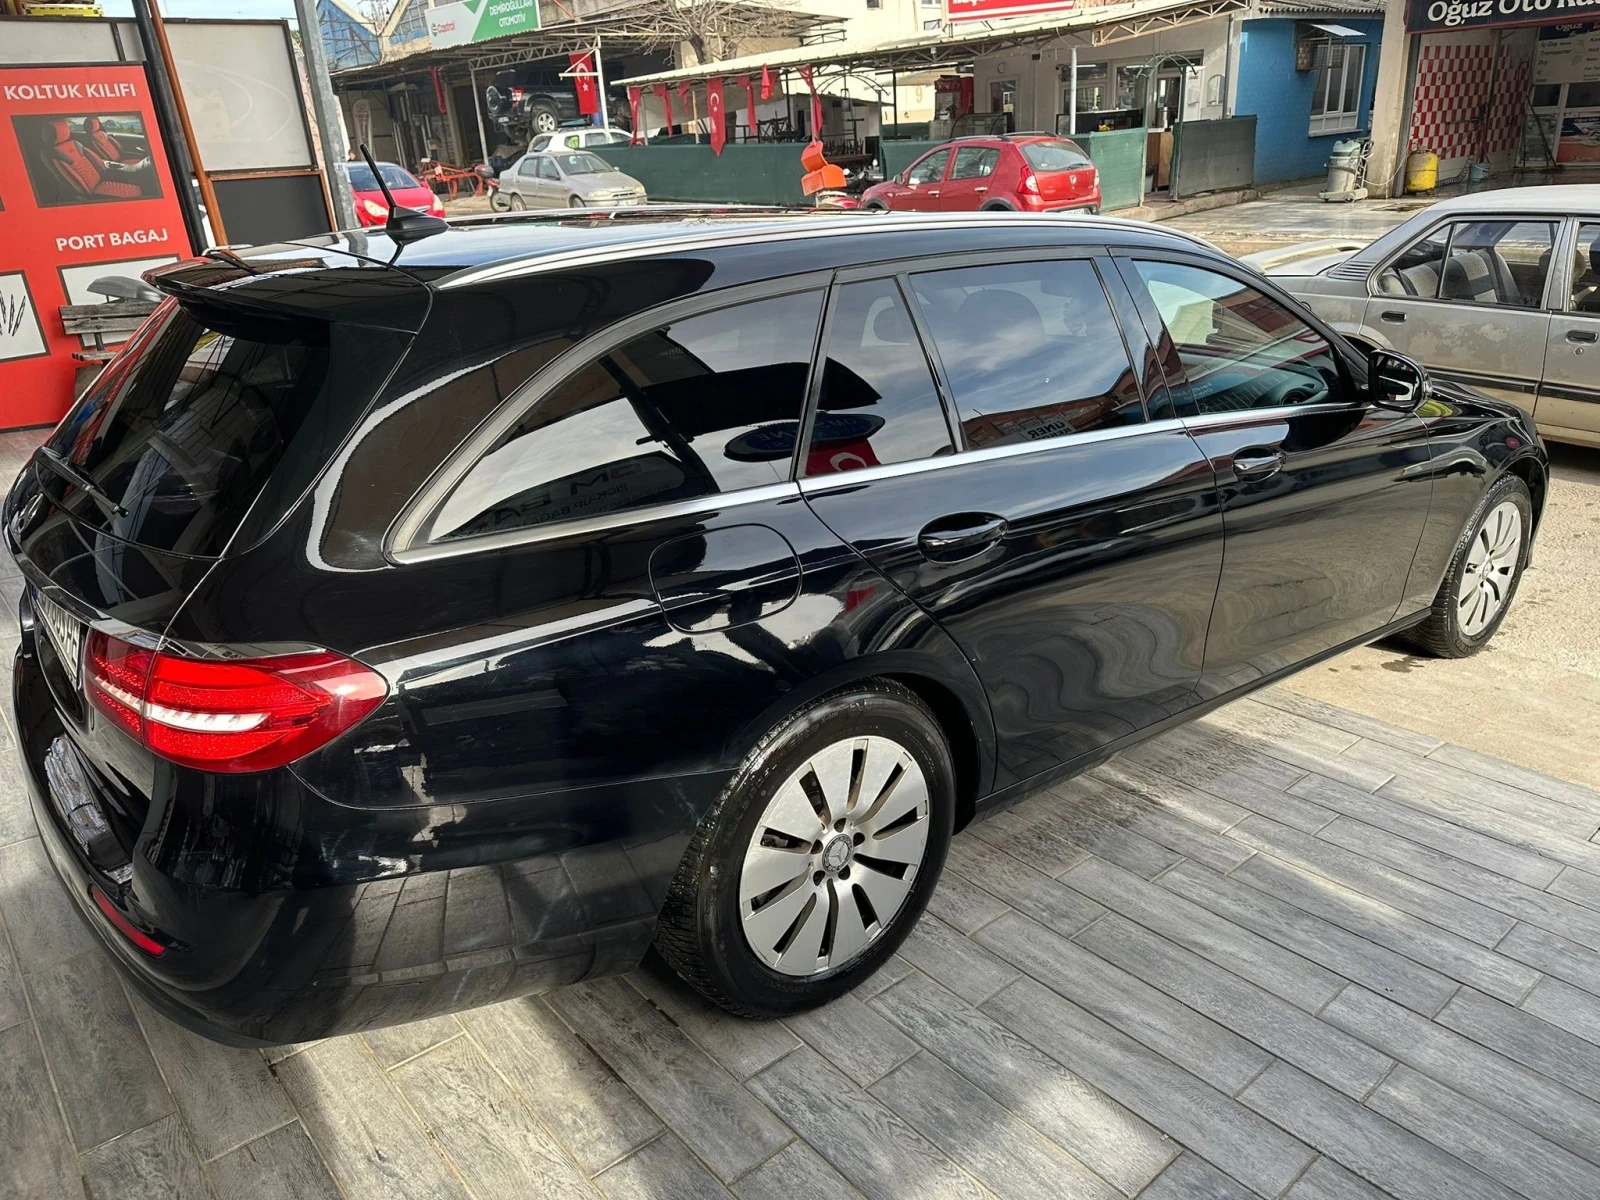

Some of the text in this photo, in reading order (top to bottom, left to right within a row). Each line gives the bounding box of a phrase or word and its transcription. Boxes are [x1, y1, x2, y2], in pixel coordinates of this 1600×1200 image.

[1499, 0, 1552, 14] Oto
[437, 21, 455, 33] Castrol
[499, 11, 526, 27] OTOMOTİV
[4, 83, 136, 100] KOLTUK KILIFI
[55, 228, 168, 251] PORT BAGAJ
